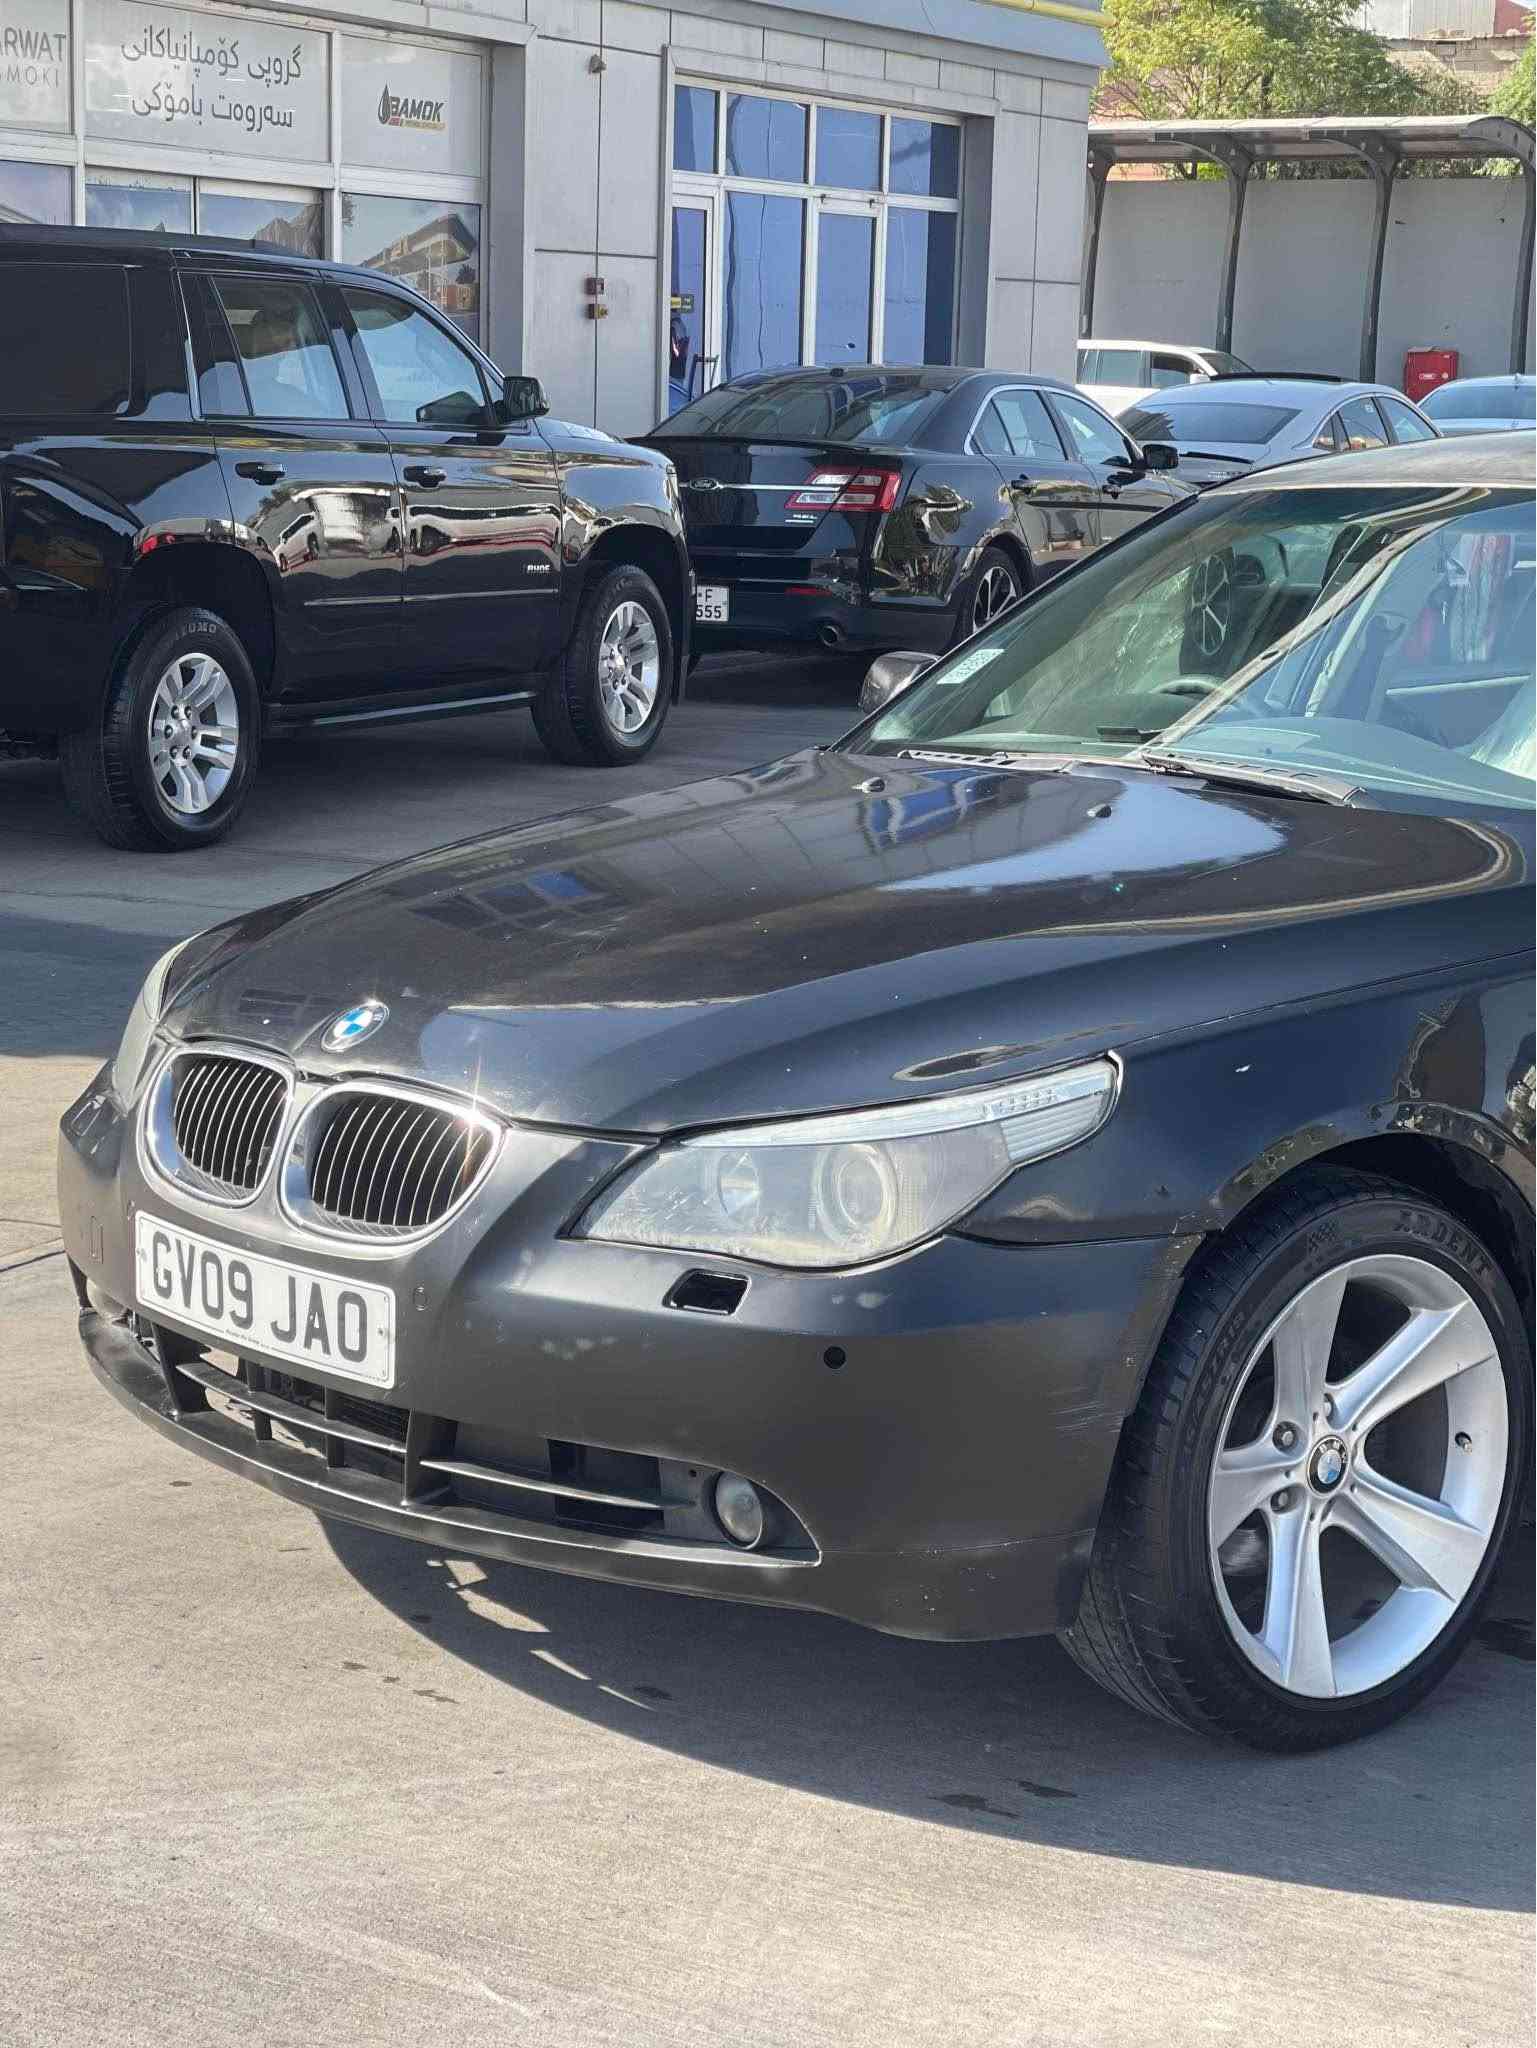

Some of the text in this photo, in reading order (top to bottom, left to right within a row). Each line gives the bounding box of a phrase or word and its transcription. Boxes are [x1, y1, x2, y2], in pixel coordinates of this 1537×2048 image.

[0, 27, 66, 61] RWAT
[0, 64, 59, 89] MOKI
[389, 96, 445, 122] BAMOK
[152, 1230, 368, 1363] GV09 JAO
